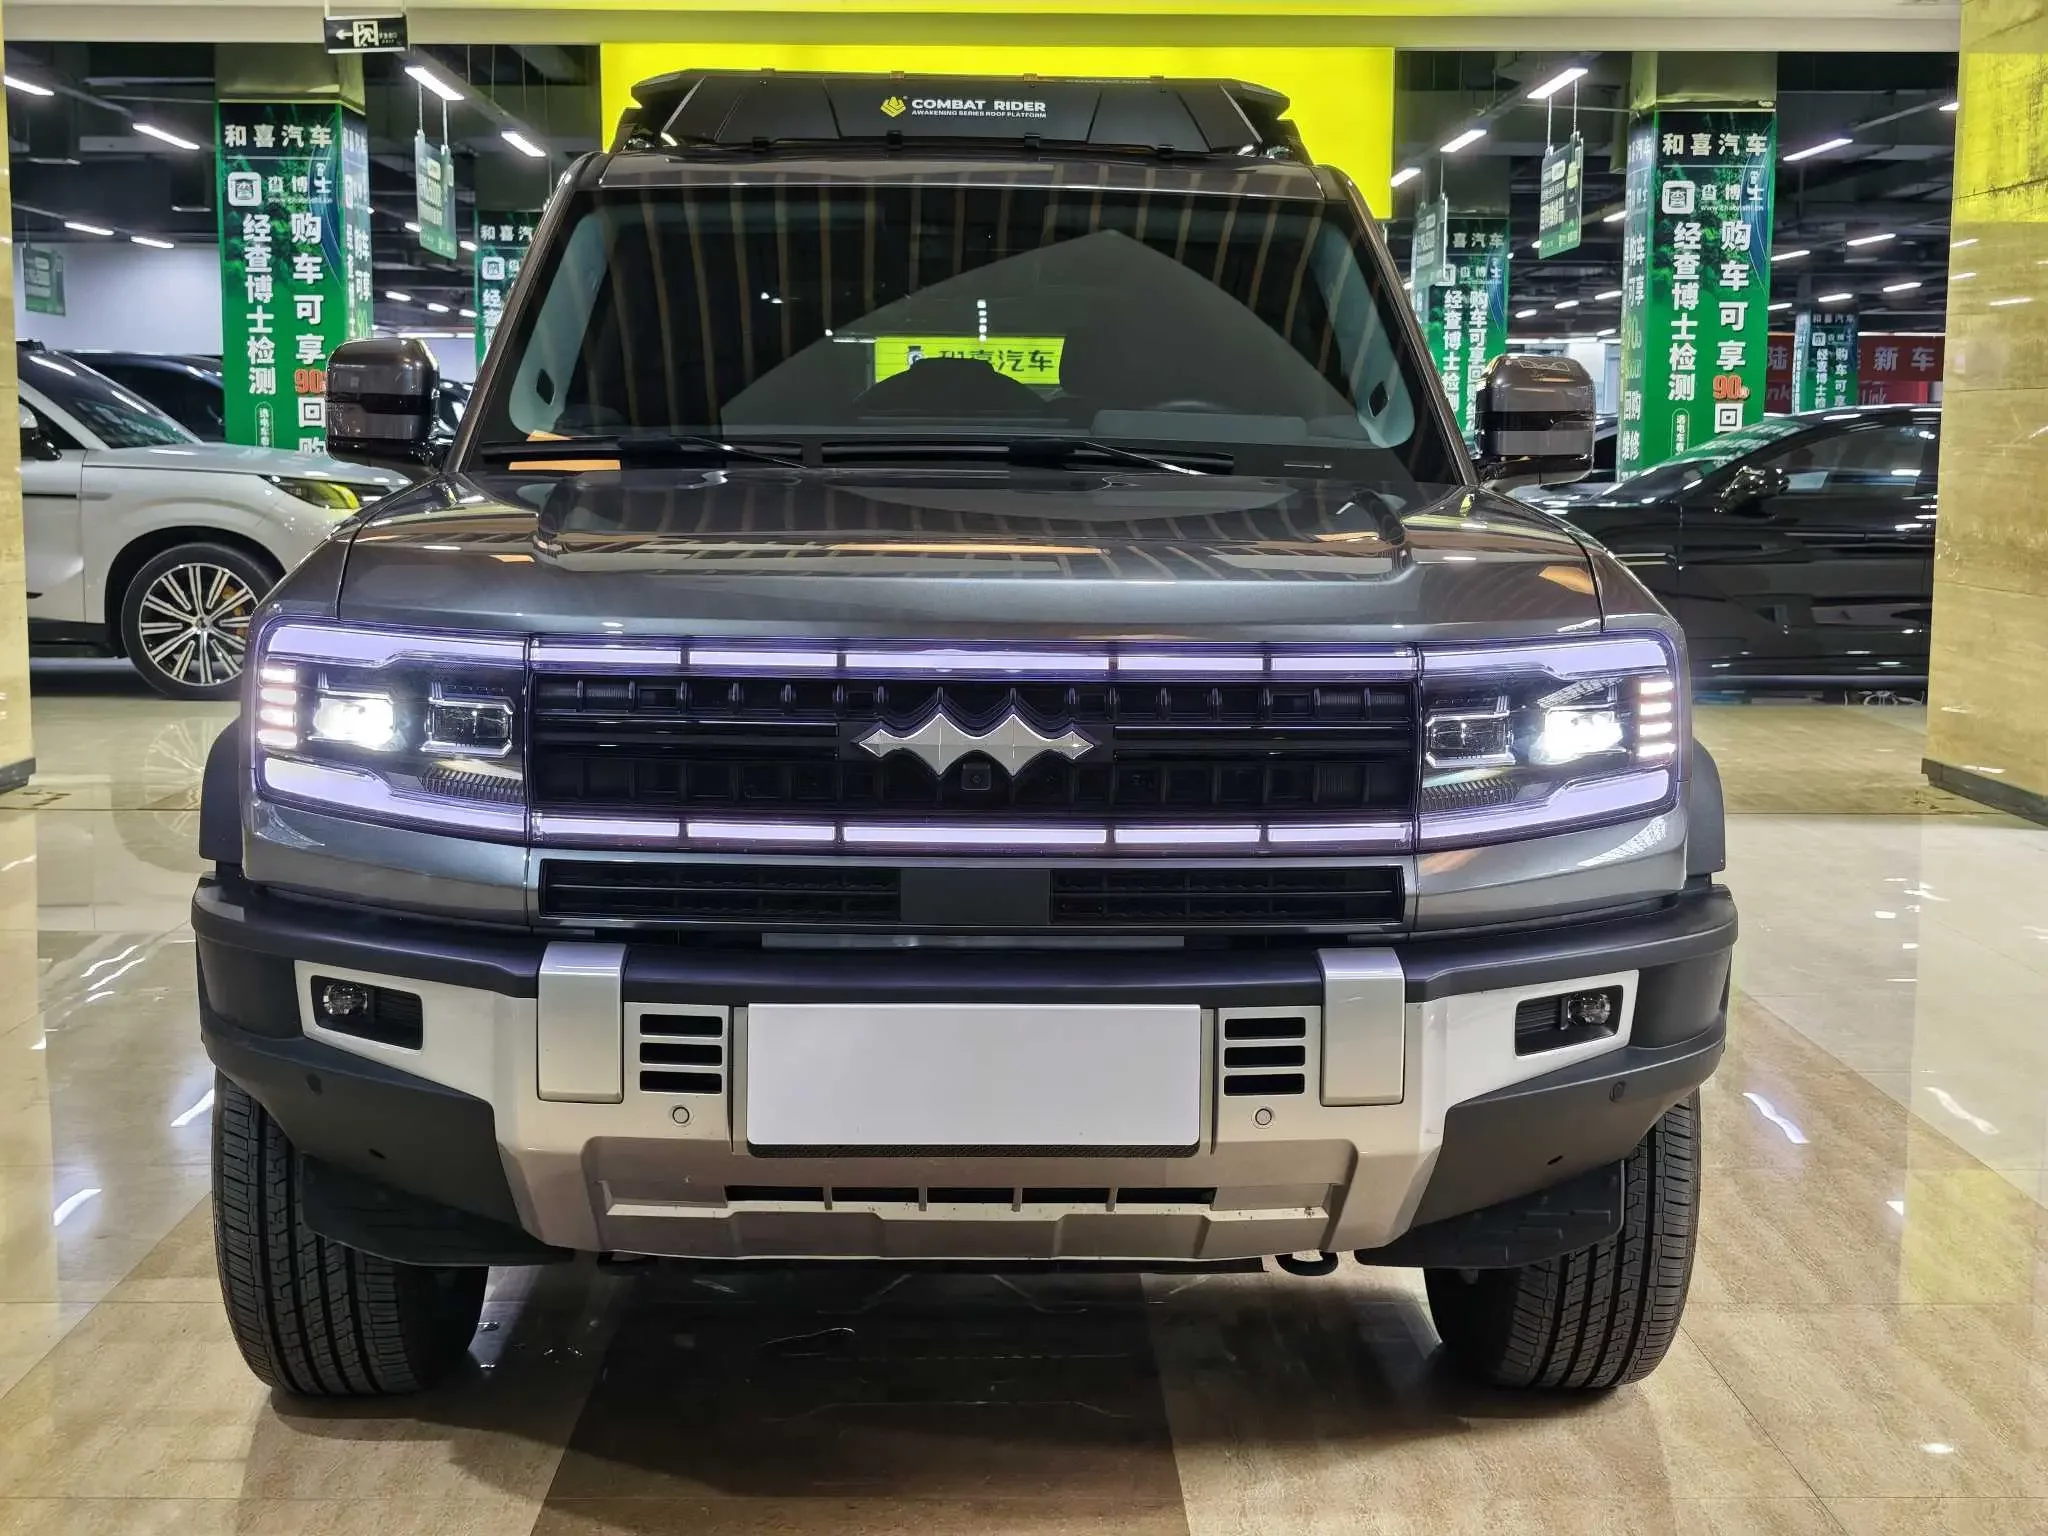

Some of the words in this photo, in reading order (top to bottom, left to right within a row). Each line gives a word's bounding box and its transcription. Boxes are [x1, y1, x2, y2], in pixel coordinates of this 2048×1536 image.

[911, 99, 986, 110] COMBAT
[993, 100, 1046, 112] RIDER
[911, 109, 957, 117] AWAKENING
[1007, 111, 1047, 119] PLATFORM
[224, 123, 333, 148] 和喜汽车
[1662, 132, 1769, 156] 和喜汽车
[1700, 184, 1765, 201] 查博士
[1446, 232, 1504, 248] 喜汽车
[242, 213, 277, 395] 经查博士检测
[1668, 221, 1701, 401] 经查博士检测
